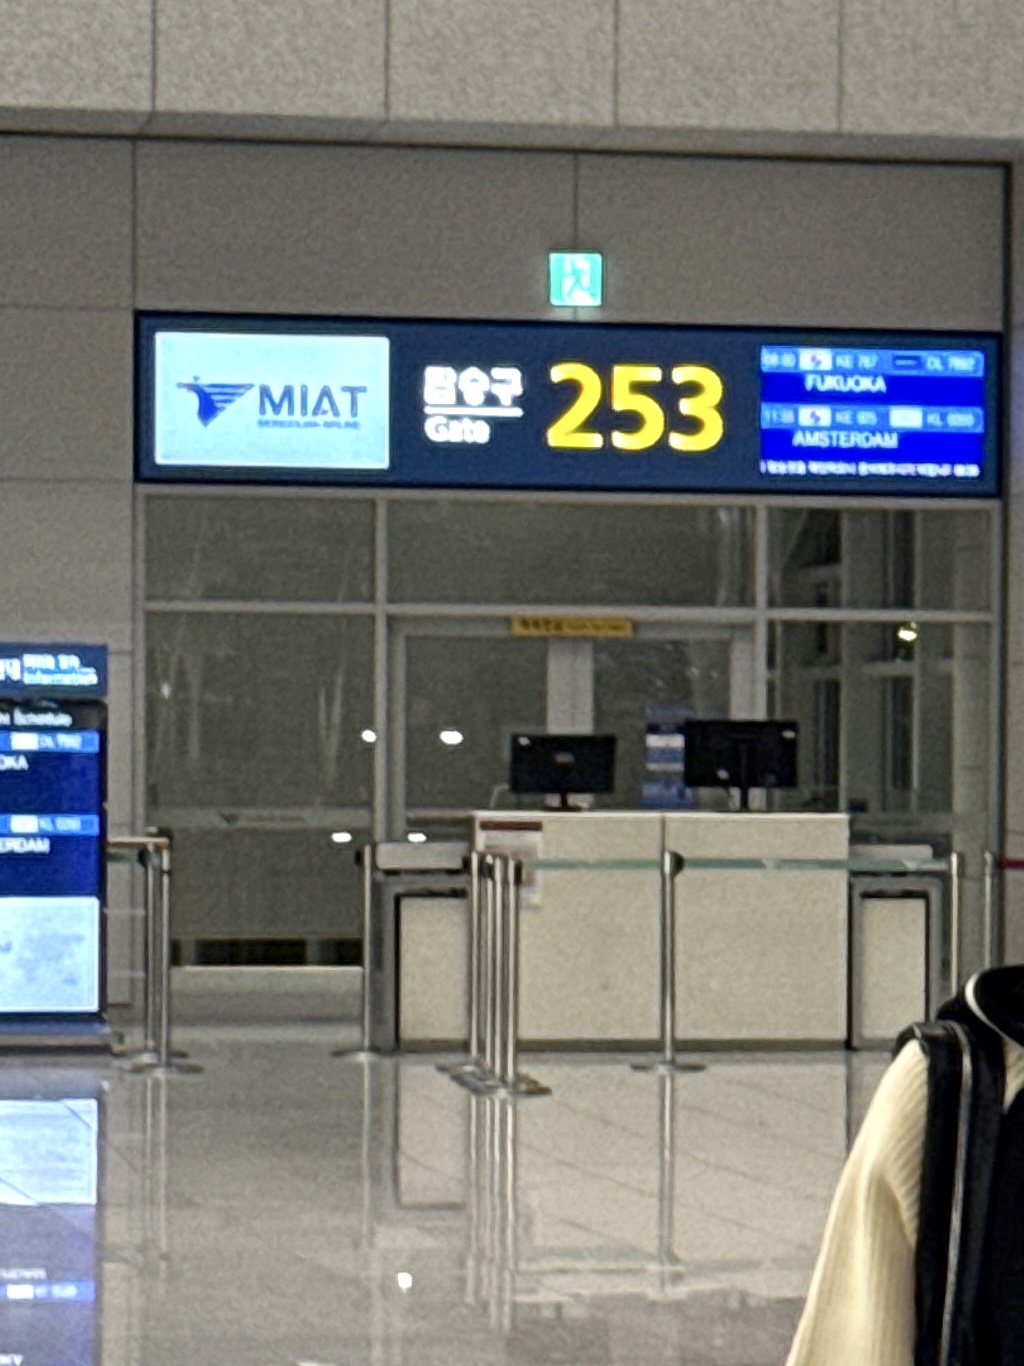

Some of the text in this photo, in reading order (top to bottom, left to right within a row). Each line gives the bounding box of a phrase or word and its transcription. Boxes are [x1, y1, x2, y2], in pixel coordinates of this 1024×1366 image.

[424, 365, 524, 406] 탑승구
[805, 374, 887, 393] FUKUOKA
[259, 383, 367, 418] MIAT
[547, 361, 724, 452] 253
[424, 416, 491, 443] Gate
[792, 430, 898, 449] AMSTERDAM
